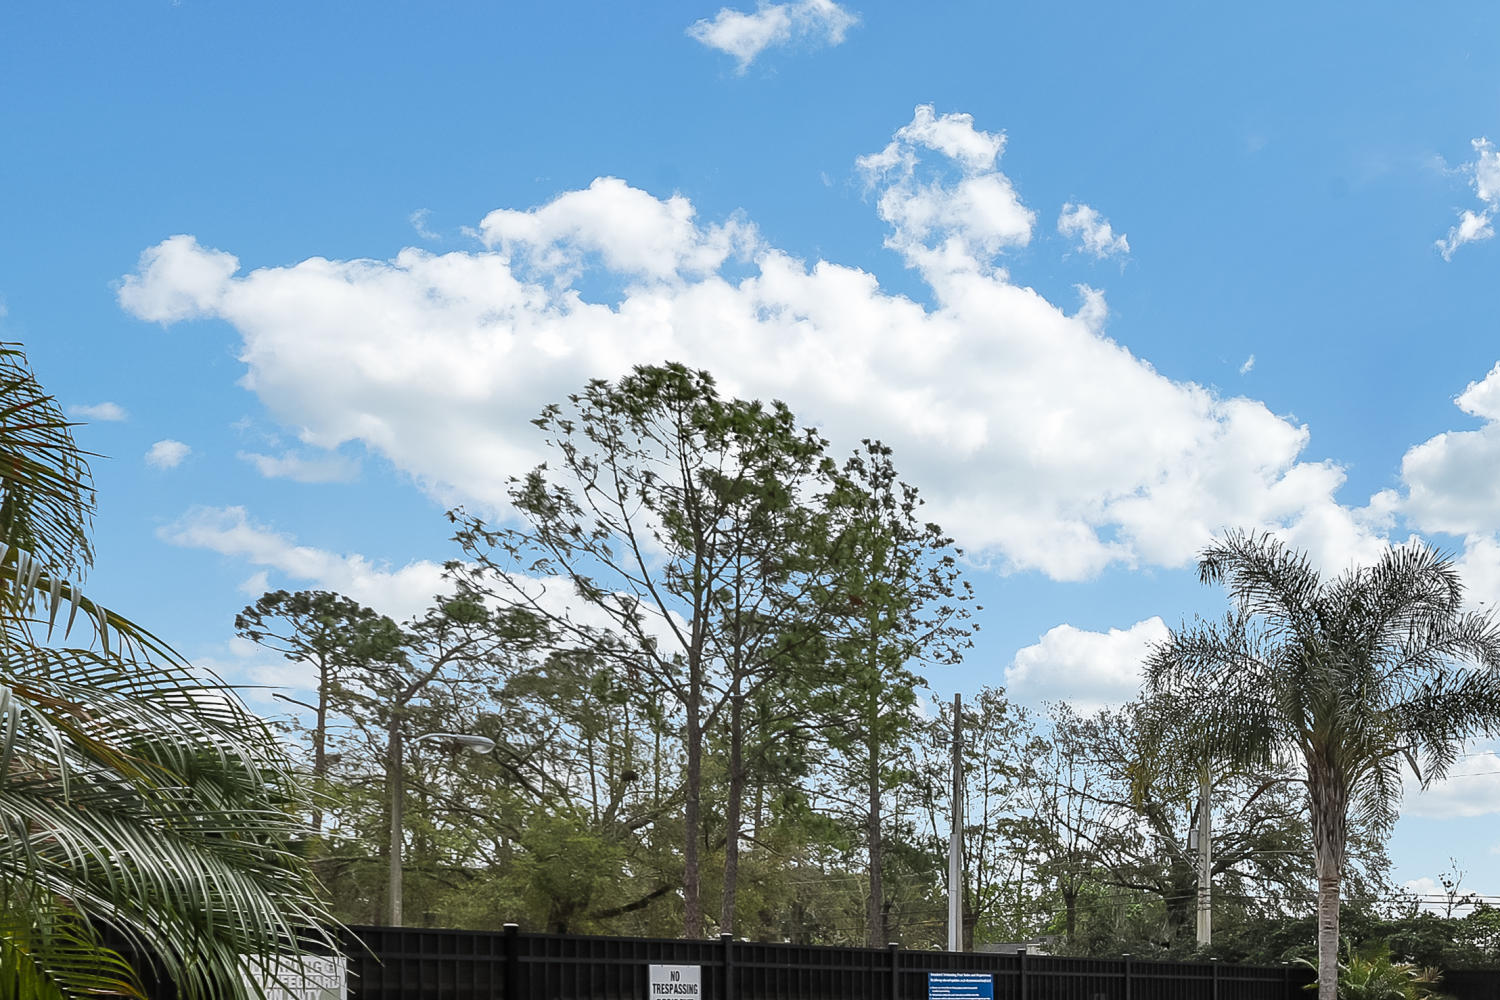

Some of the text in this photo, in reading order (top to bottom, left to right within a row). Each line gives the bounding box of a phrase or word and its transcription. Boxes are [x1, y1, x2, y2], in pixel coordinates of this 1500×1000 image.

[670, 971, 680, 982] NO
[287, 988, 321, 1000] DUTY
[652, 983, 698, 994] TRESPASSING
